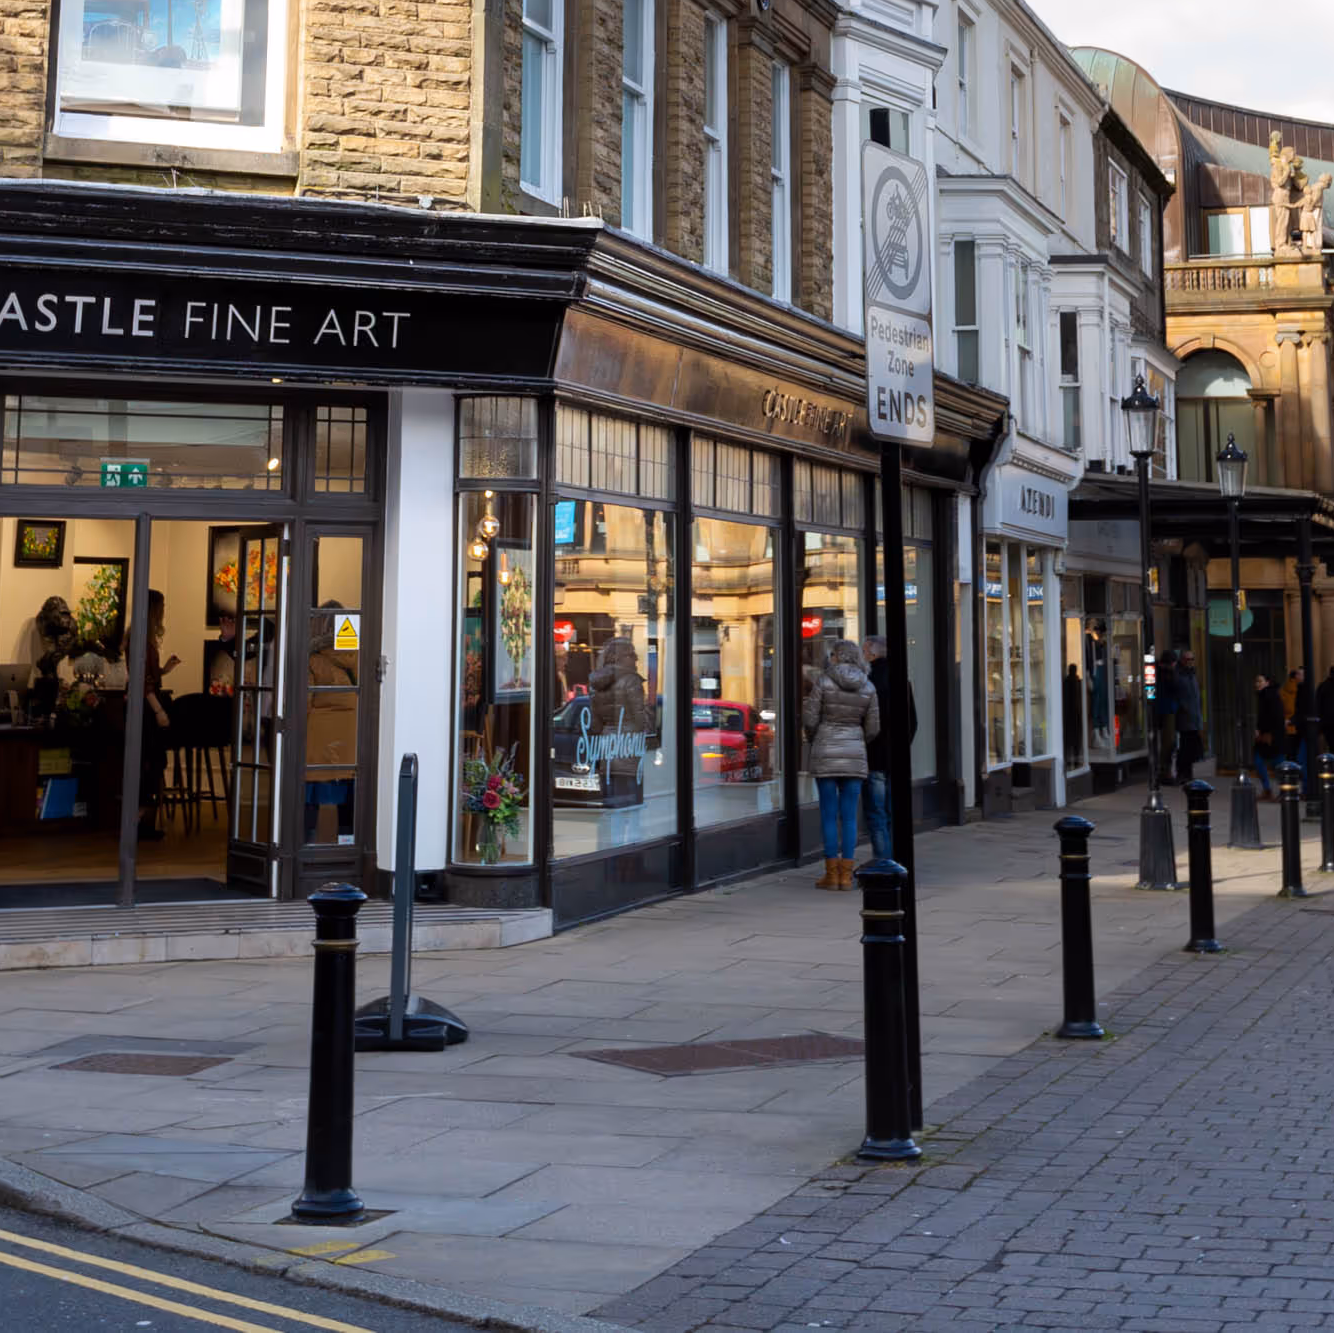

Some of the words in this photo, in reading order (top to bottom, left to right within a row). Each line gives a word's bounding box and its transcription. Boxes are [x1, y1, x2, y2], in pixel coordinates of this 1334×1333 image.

[184, 302, 292, 344] FINE
[314, 309, 411, 348] ART
[870, 315, 930, 353] Pedestrian
[888, 350, 914, 377] Zone
[762, 388, 807, 426] CASTLE
[807, 402, 830, 434] FINE
[877, 386, 927, 428] ENDS
[1020, 485, 1055, 519] AZENDI
[576, 706, 646, 785] Symphony
